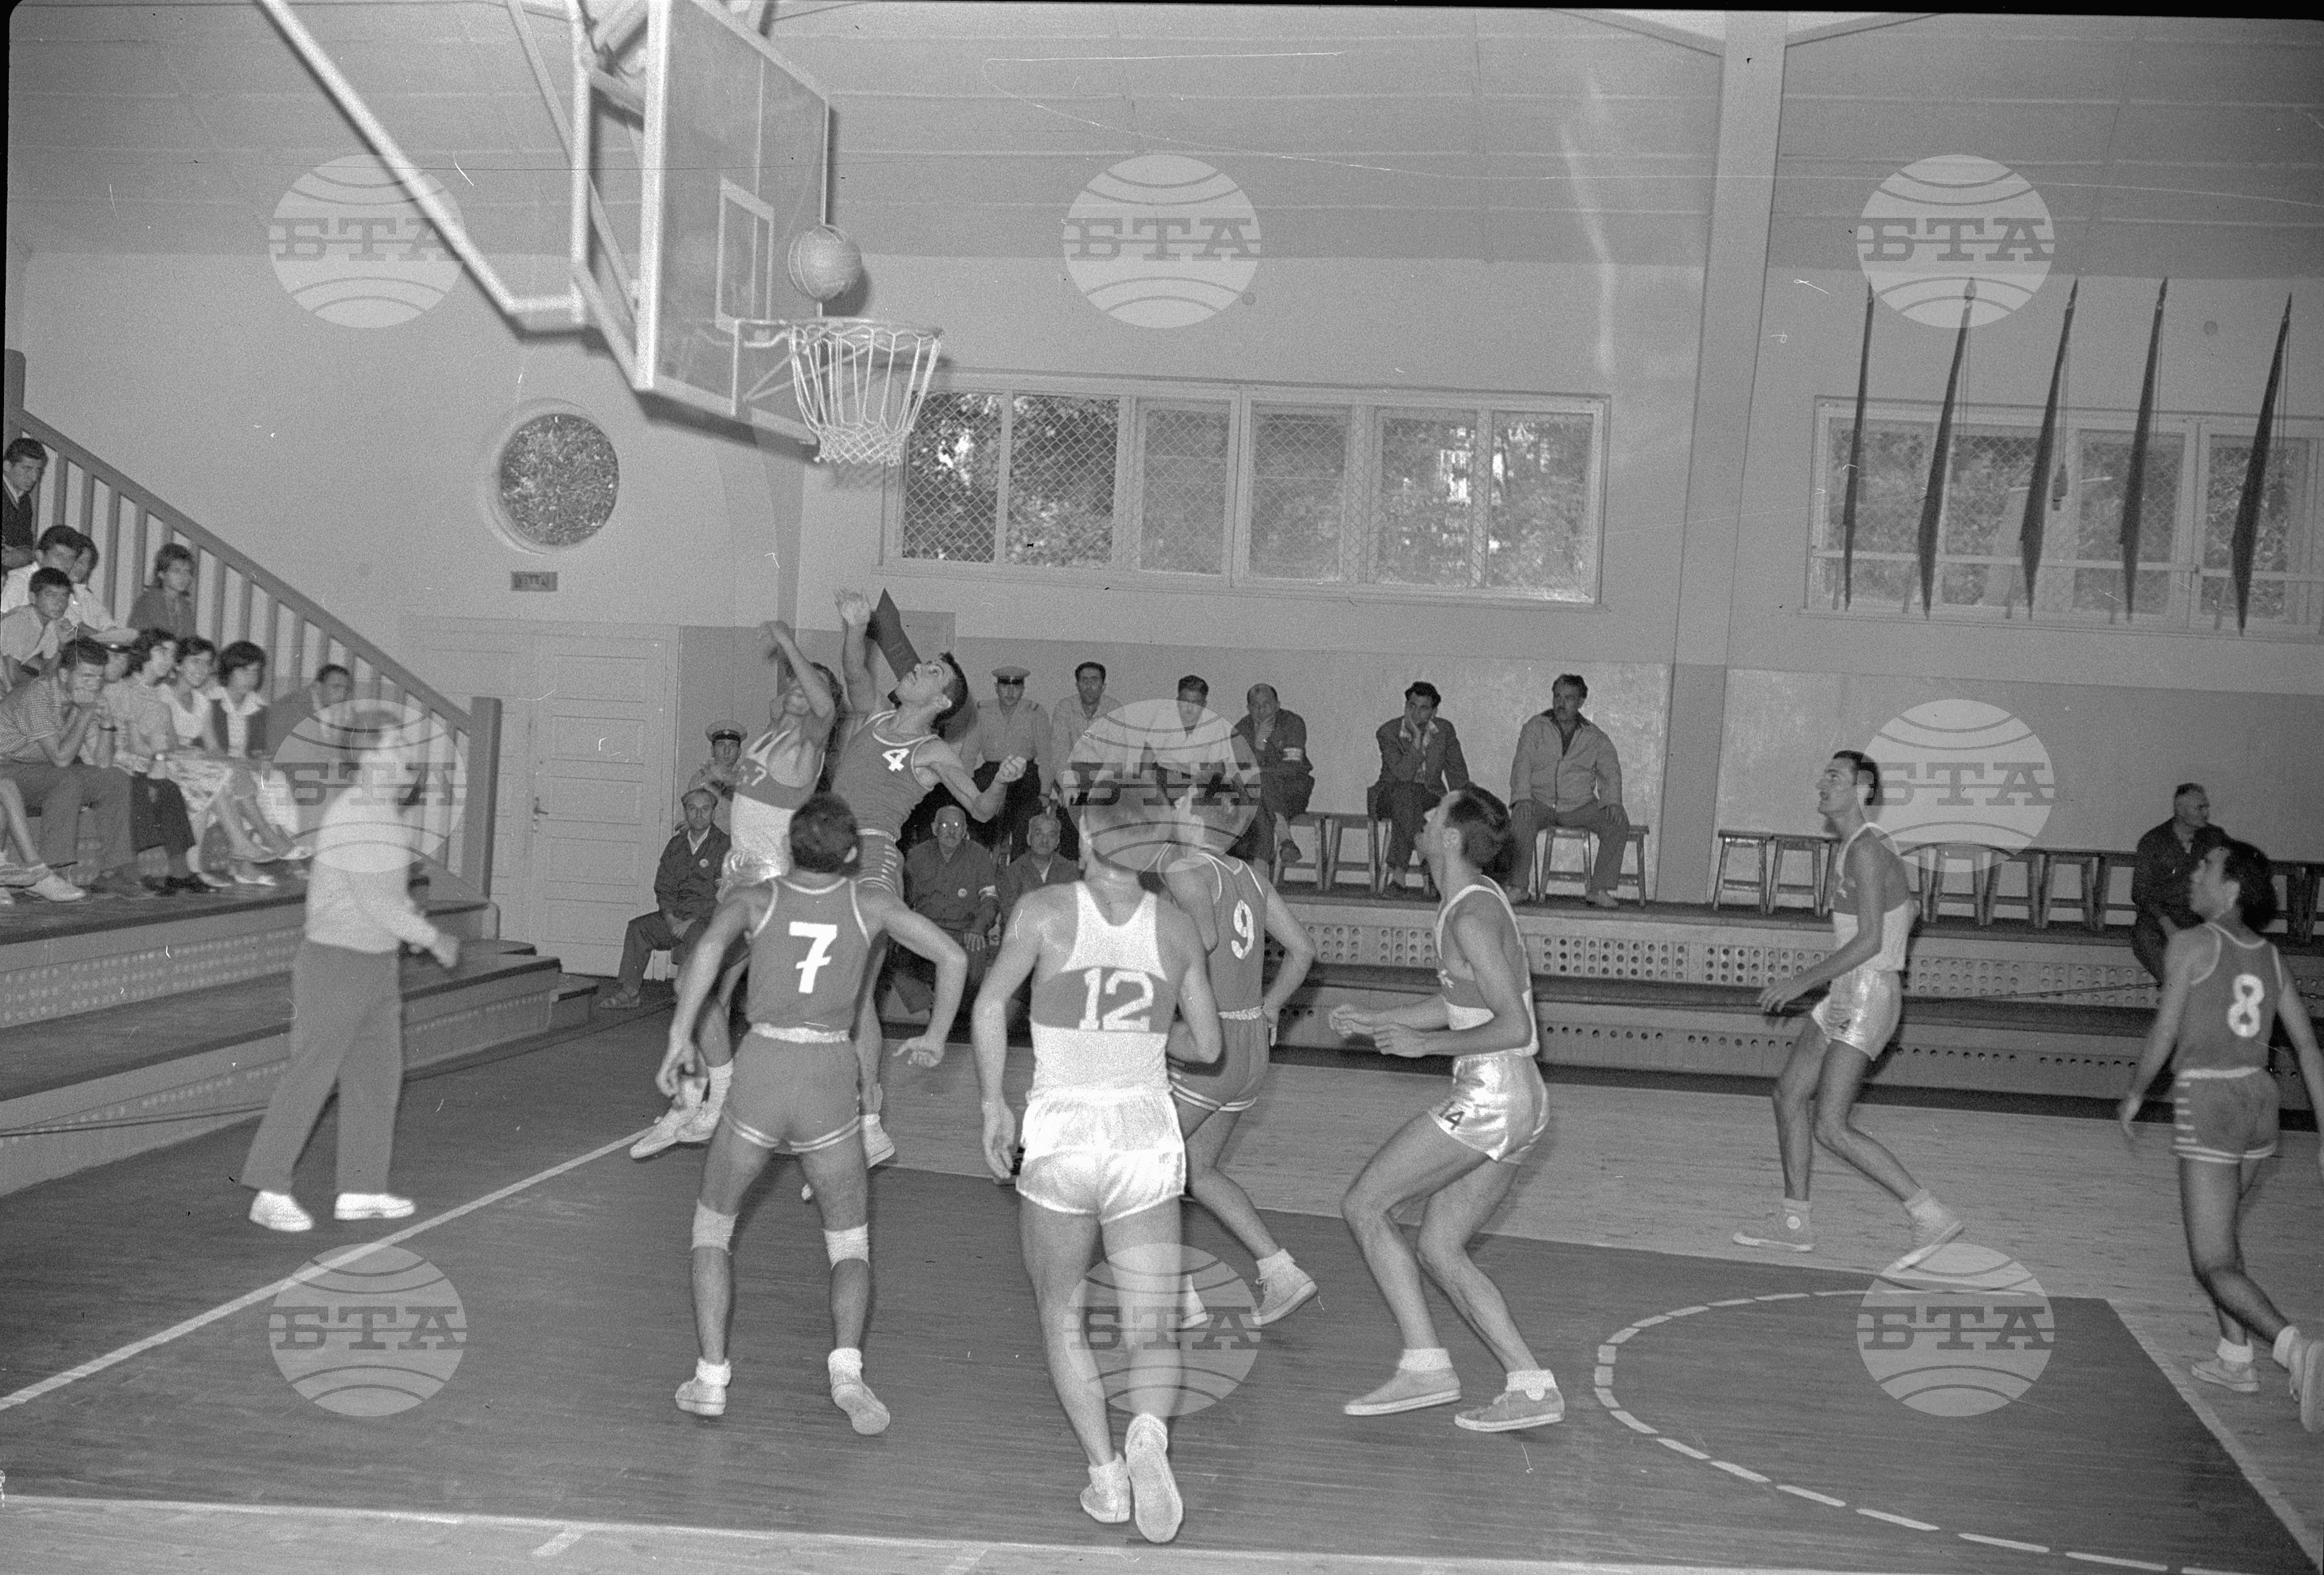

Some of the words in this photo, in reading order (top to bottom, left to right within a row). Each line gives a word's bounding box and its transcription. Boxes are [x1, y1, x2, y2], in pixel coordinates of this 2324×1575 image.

[882, 747, 910, 772] 4
[788, 921, 838, 994] 7
[1231, 899, 1255, 960] 9
[1079, 967, 1154, 1032] 12
[2226, 973, 2265, 1038] 8
